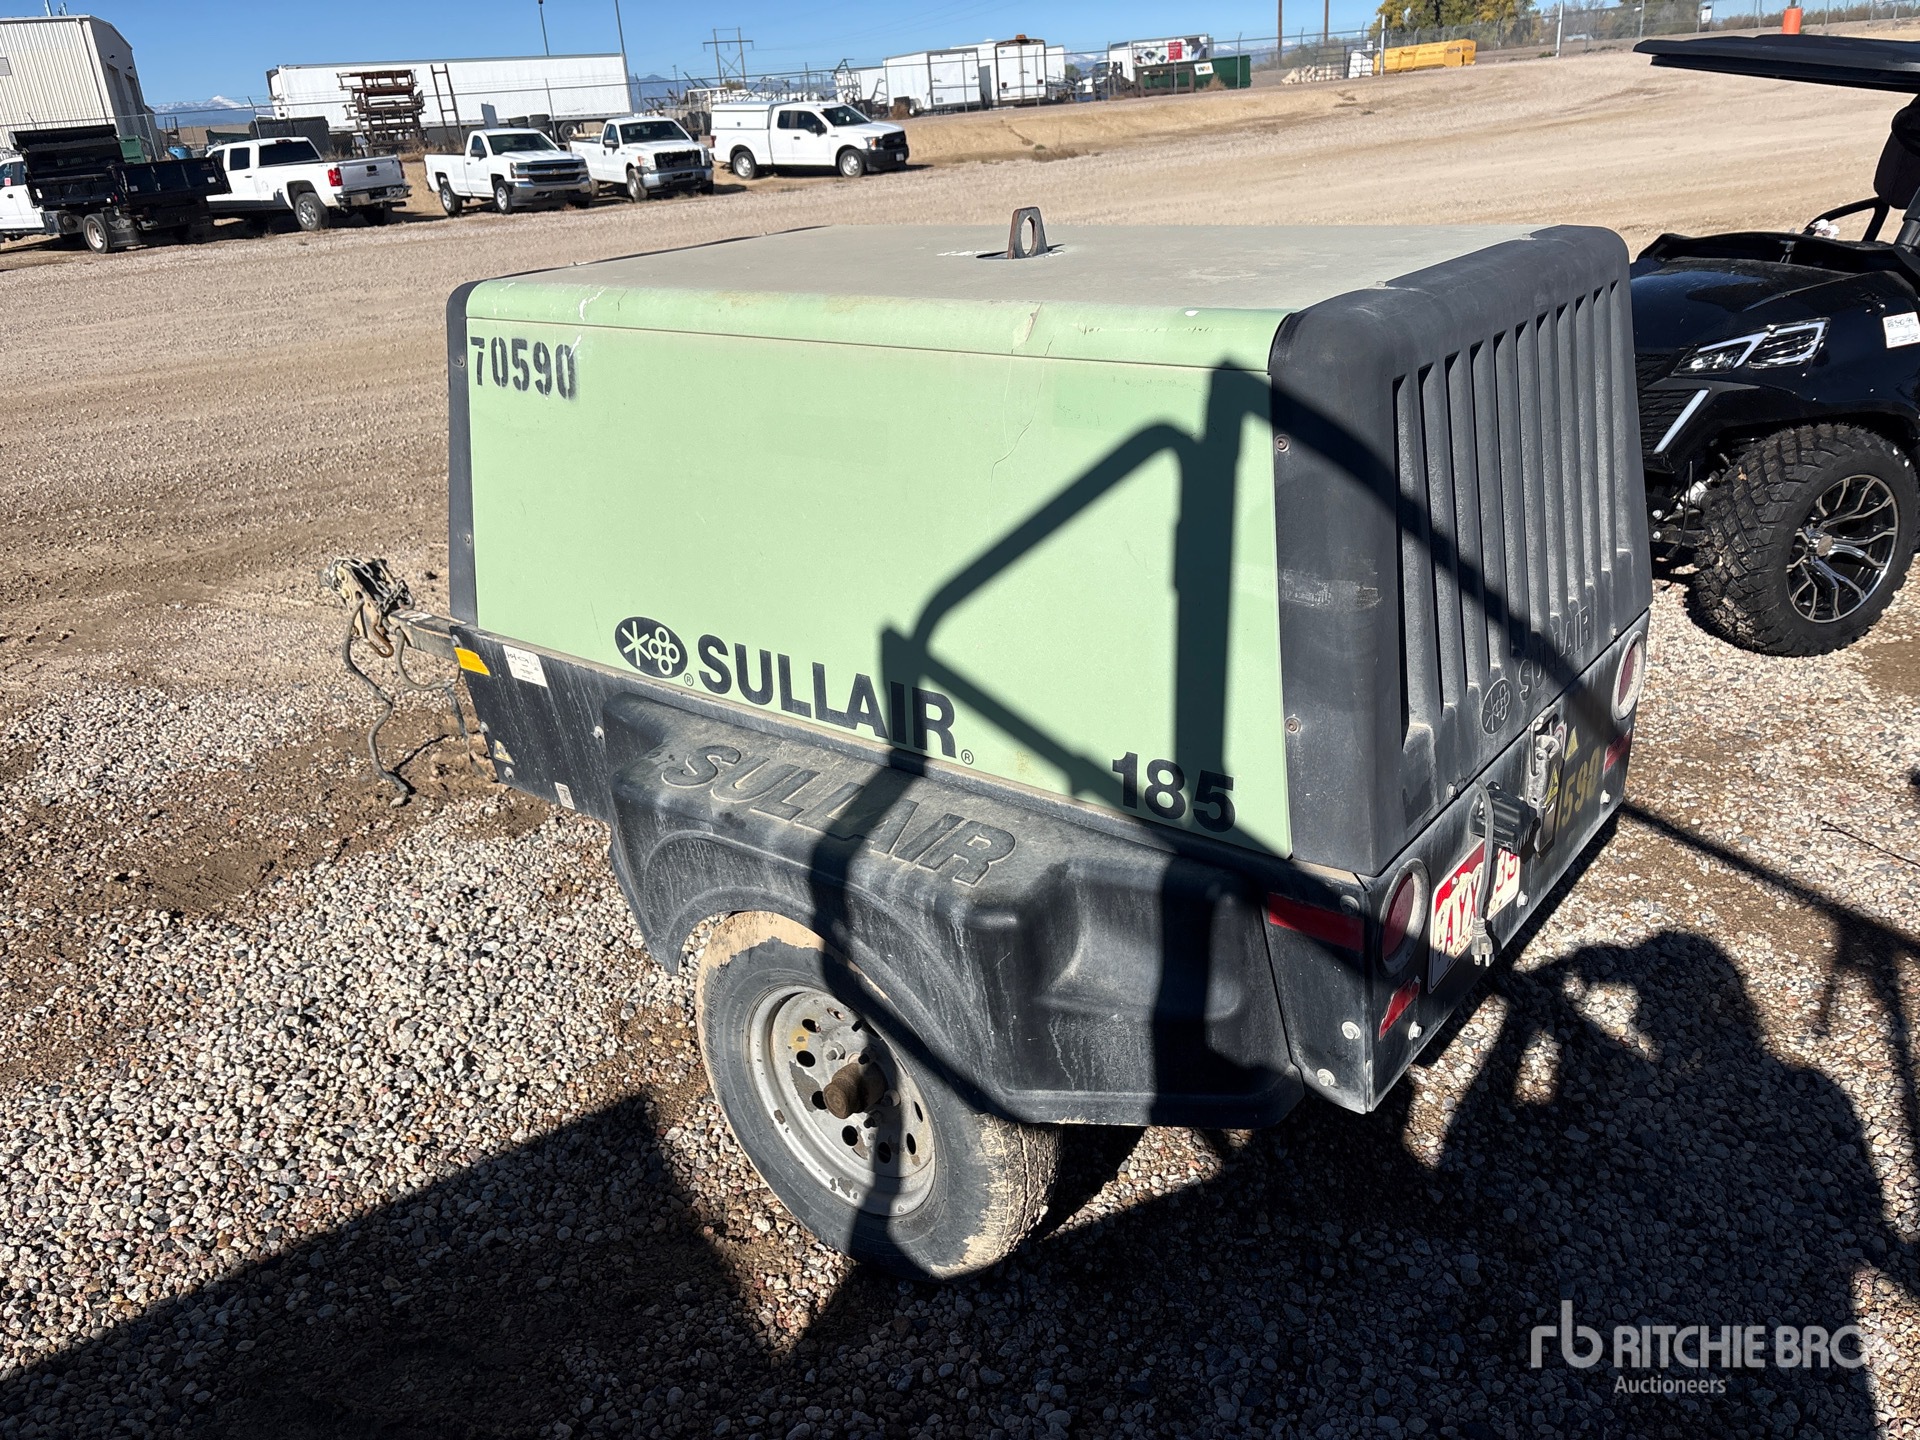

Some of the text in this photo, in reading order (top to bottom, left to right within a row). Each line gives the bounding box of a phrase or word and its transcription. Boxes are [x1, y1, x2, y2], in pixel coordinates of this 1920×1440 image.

[470, 337, 577, 400] 70590
[698, 634, 957, 758] SULLAIR
[661, 745, 1015, 887] SULLAIR
[1112, 752, 1235, 832] 185
